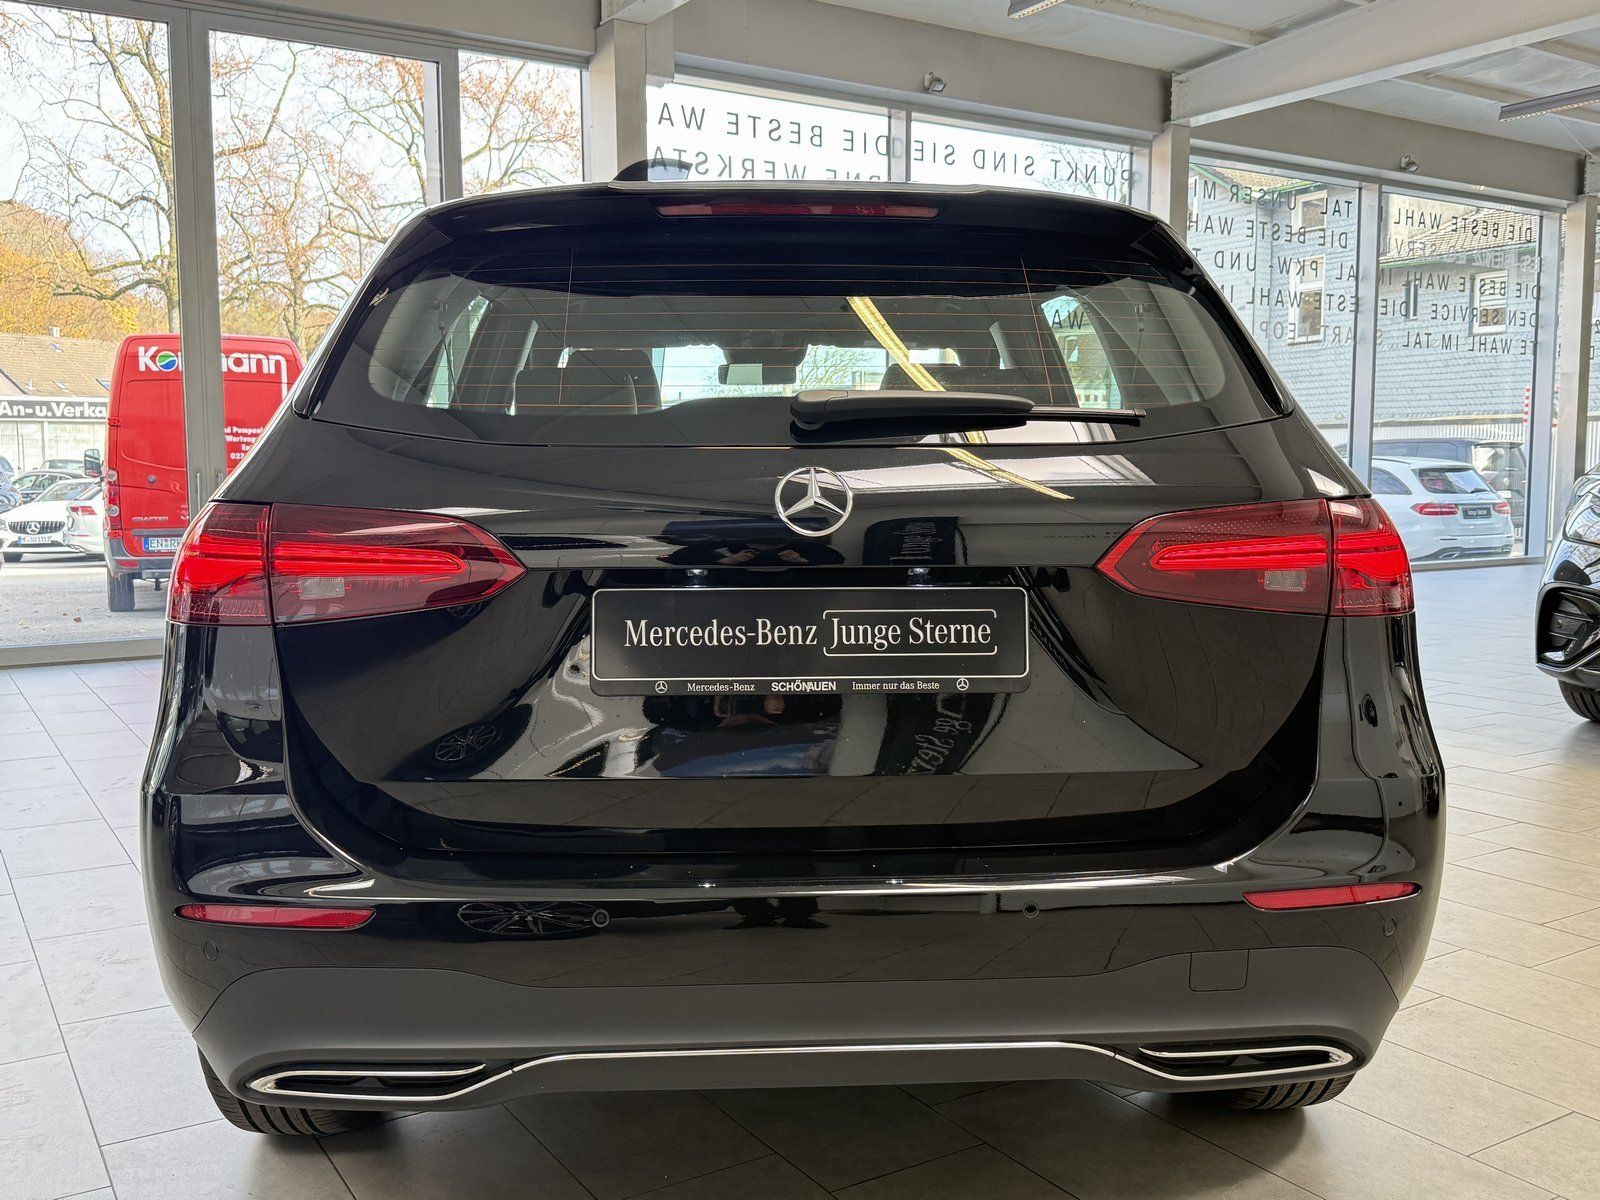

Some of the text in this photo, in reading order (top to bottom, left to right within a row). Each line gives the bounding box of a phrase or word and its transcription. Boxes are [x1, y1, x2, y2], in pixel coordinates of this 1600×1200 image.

[624, 616, 992, 651] Mercedes-Benz Junge Sterne
[687, 682, 756, 693] Mercedes-Benz
[852, 681, 881, 690] Immer
[899, 681, 915, 690] das
[916, 681, 940, 690] Beste
